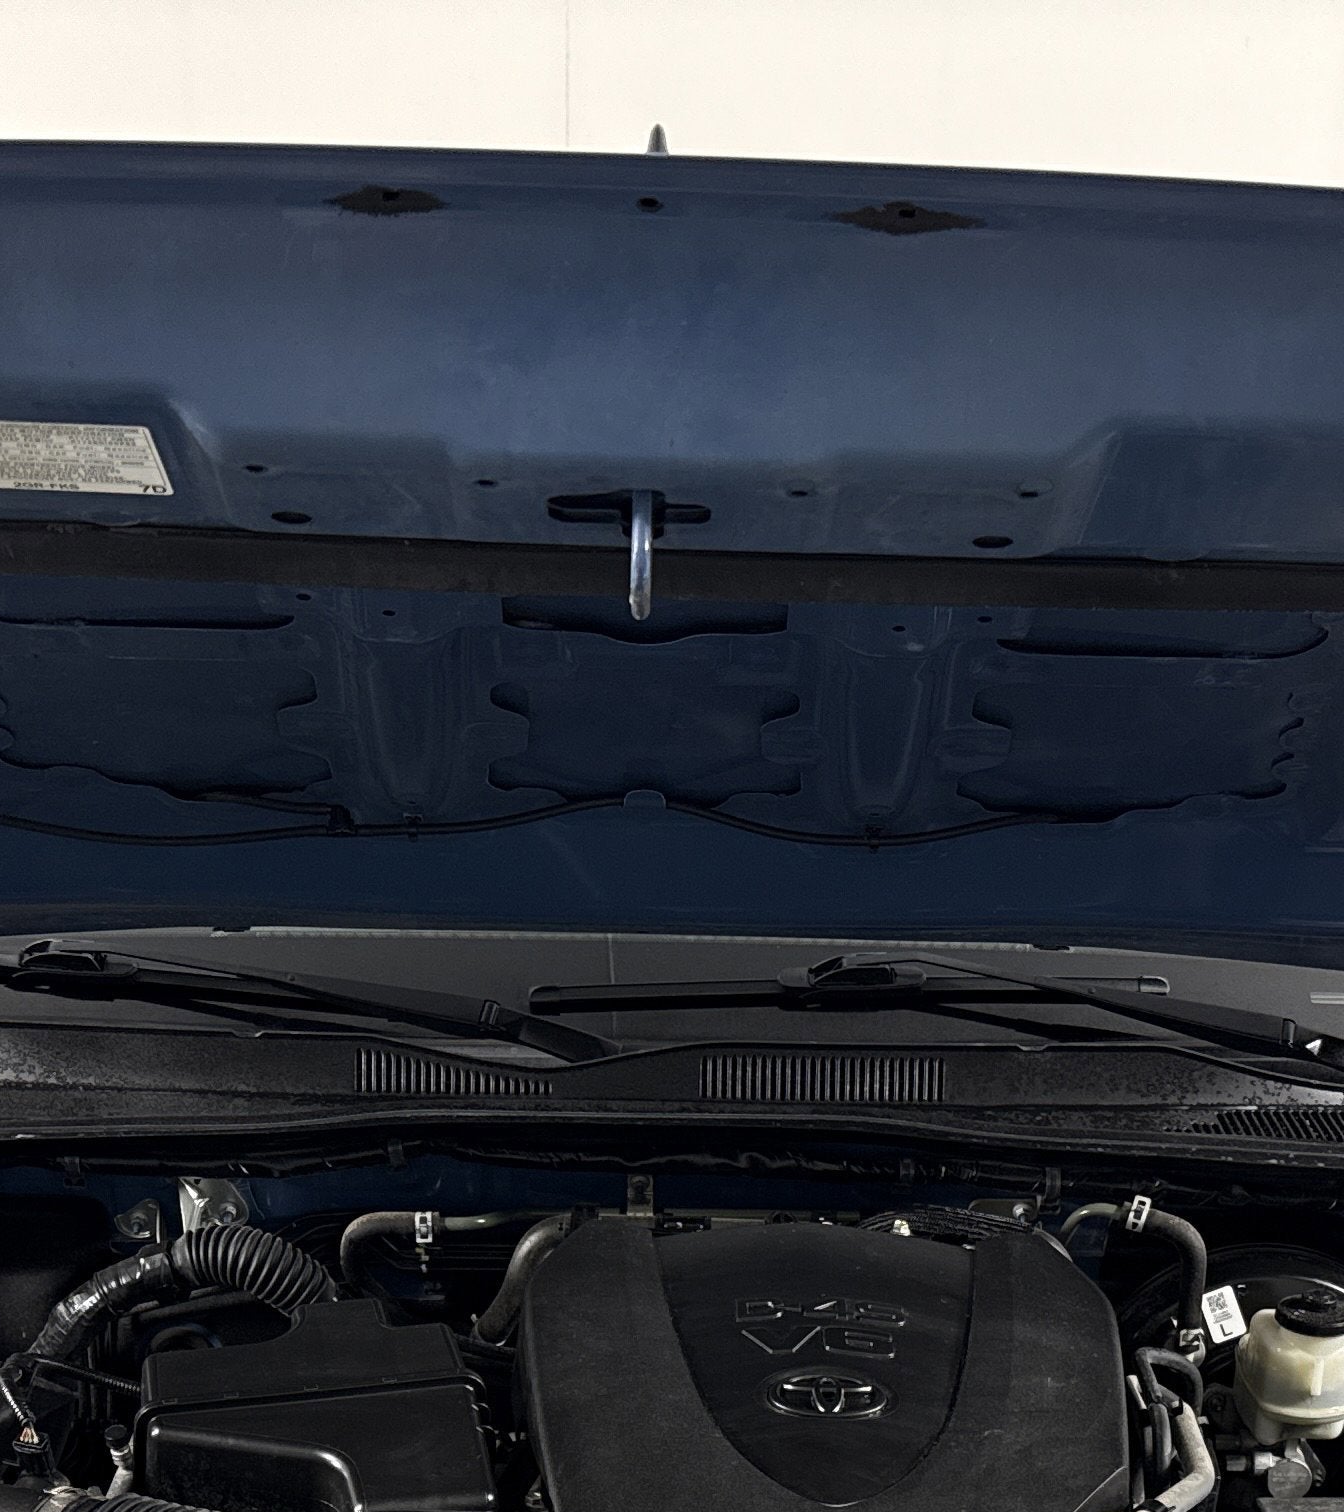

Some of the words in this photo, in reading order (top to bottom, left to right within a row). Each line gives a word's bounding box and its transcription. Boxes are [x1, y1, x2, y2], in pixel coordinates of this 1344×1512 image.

[736, 1298, 906, 1327] D-4S
[741, 1325, 897, 1360] V6
[1220, 1324, 1233, 1337] L
